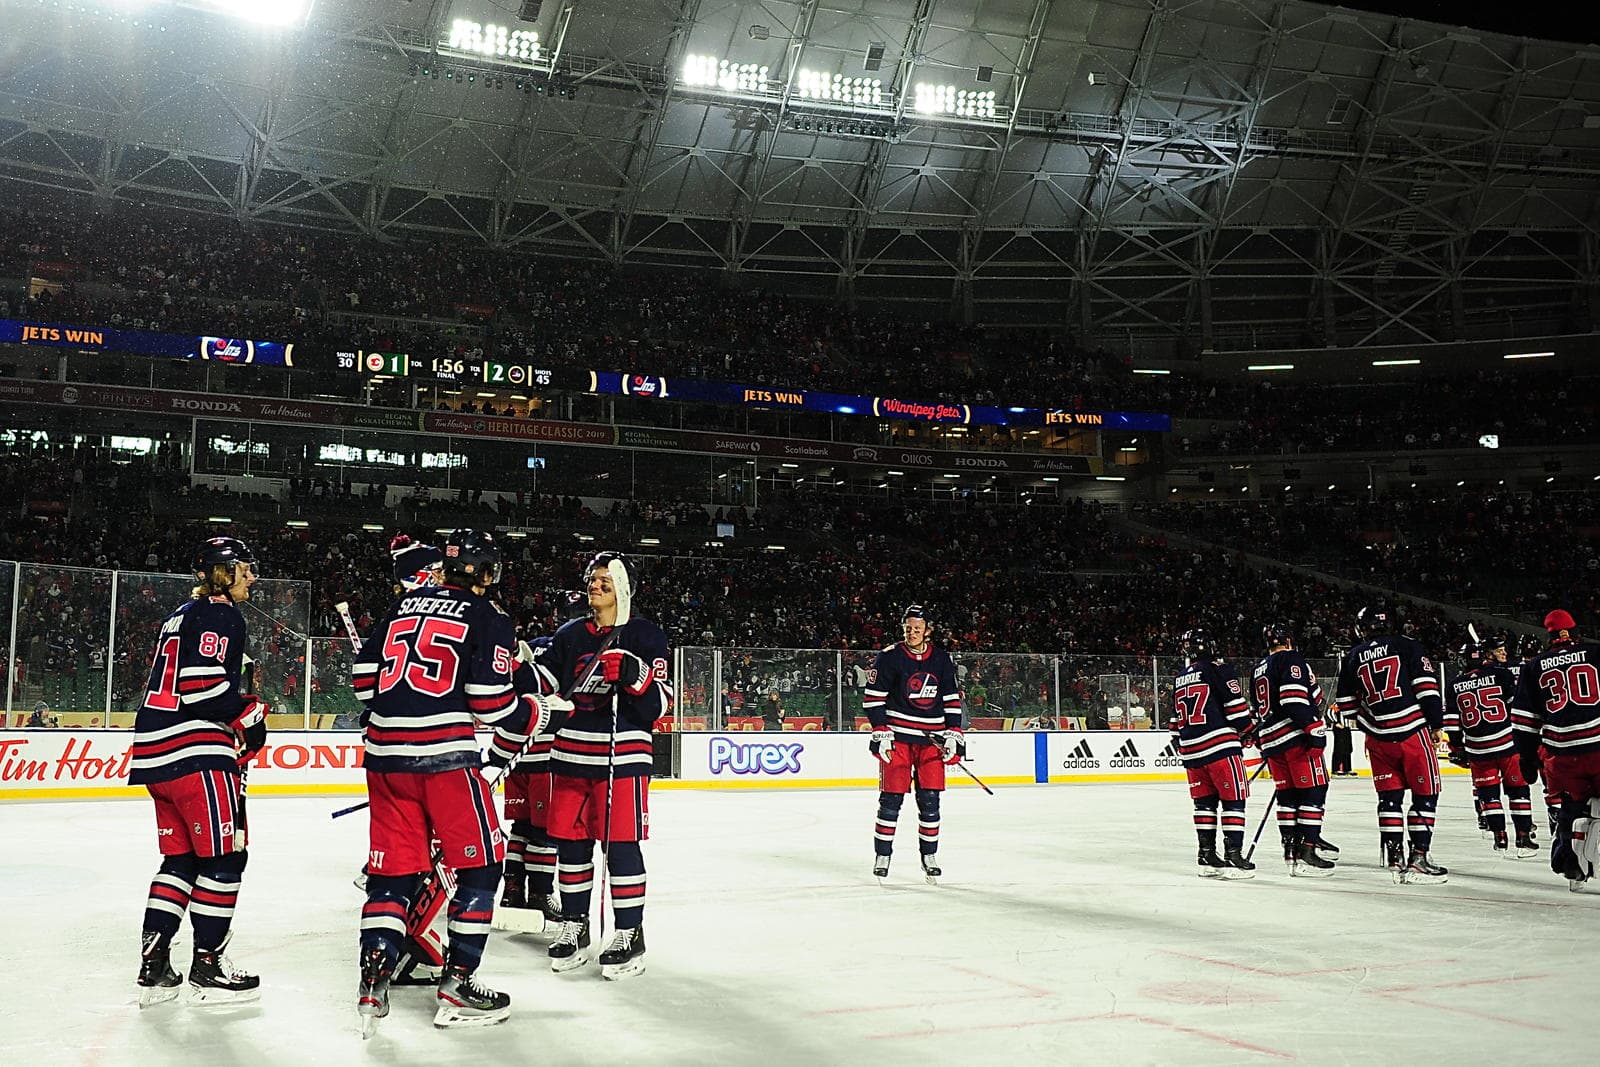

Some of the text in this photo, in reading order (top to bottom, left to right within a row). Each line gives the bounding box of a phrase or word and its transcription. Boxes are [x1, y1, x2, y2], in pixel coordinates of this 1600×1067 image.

[22, 326, 104, 345] JETS WIN
[338, 358, 353, 368] 30
[391, 356, 398, 372] 1
[411, 360, 423, 368] TOL
[432, 358, 465, 374] 1:56
[437, 372, 456, 380] FINAL
[493, 364, 505, 381] 2
[536, 375, 550, 385] 45
[744, 389, 803, 405] JETS WIN
[171, 398, 242, 413] HONDA
[260, 404, 312, 419] Tim Hortons
[883, 399, 961, 419] Winnipeg Jets
[353, 416, 413, 426] SASKATCHEWAN
[385, 412, 412, 421] REGINA
[1046, 412, 1102, 425] JETS WIN
[488, 421, 539, 436] HERITAGE
[541, 425, 584, 439] CLASSIC
[586, 430, 606, 439] 2019
[715, 440, 750, 451] SAFEWAY
[784, 445, 830, 457] Scotiabank
[901, 453, 933, 465] OIKOS
[955, 457, 1009, 468] HONDA
[1033, 459, 1047, 470] Tim
[398, 597, 471, 618] SCHEIFELE
[199, 631, 229, 663] 81
[1359, 644, 1389, 663] LOWRY
[379, 616, 469, 697] 55
[492, 645, 513, 681] 5
[1540, 650, 1587, 671] BROSSOIT
[144, 635, 181, 712] 1
[1290, 665, 1301, 679] 9
[1357, 655, 1402, 707] 17
[1453, 675, 1496, 693] PERREAULT
[1539, 663, 1600, 713] 30
[1174, 683, 1210, 729] 57
[1457, 686, 1507, 728] 85
[0, 739, 54, 781] Tim
[709, 737, 804, 774] Purex
[1063, 758, 1100, 769] adidas
[1109, 757, 1145, 768] adidas
